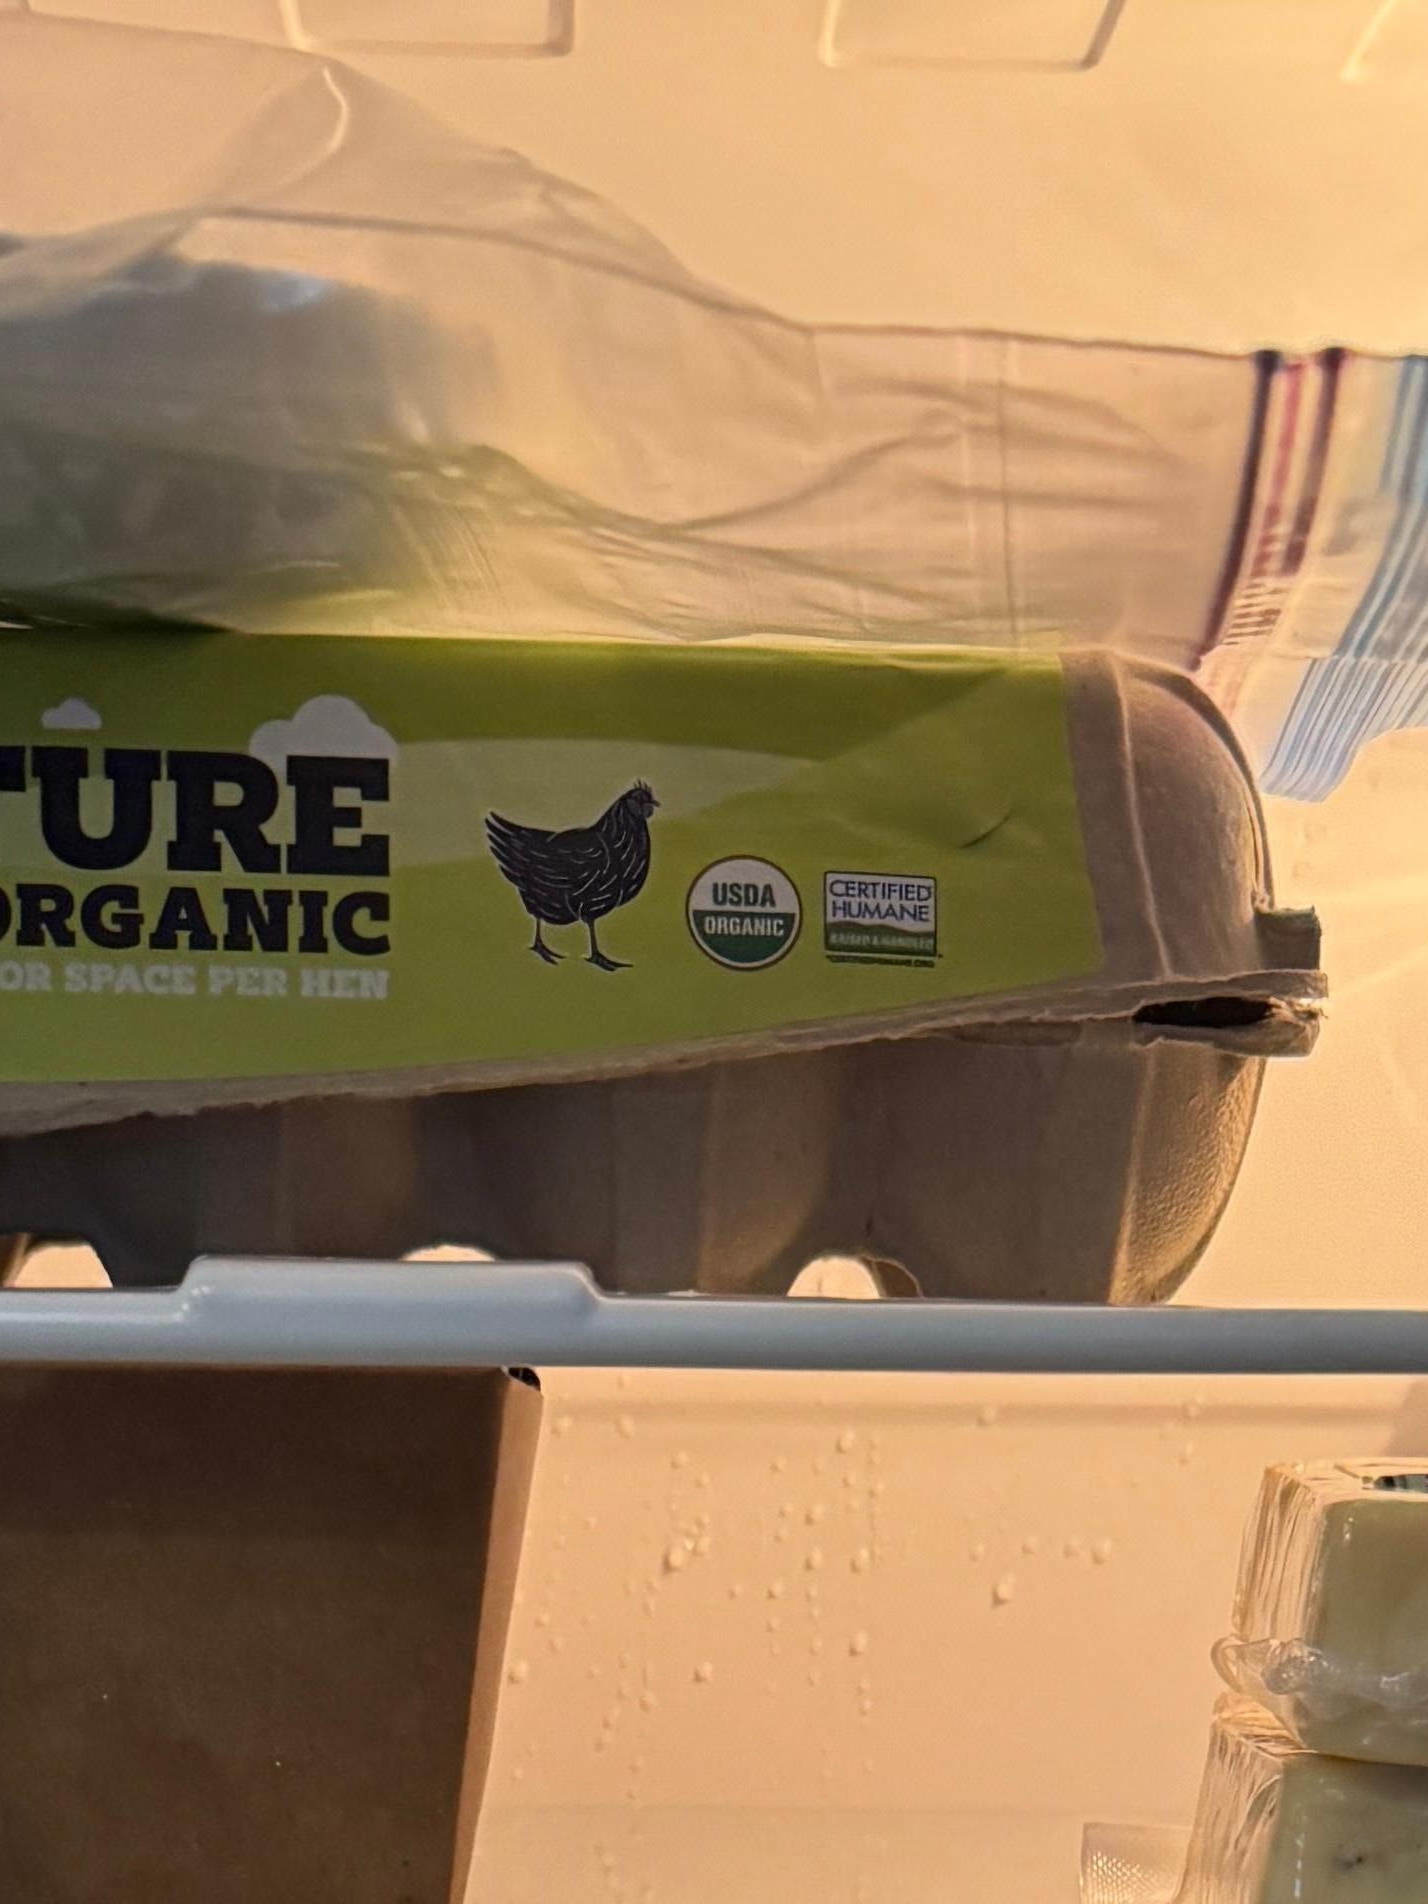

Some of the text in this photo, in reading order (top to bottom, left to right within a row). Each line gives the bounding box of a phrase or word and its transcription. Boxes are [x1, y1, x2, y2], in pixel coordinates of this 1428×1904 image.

[712, 881, 777, 909] USDA
[829, 880, 931, 901] CERTIFIED
[833, 900, 929, 922] HUMANE
[704, 916, 784, 938] ORGANIC
[65, 961, 196, 996] SPACE
[209, 965, 286, 997] PER
[300, 969, 389, 999] HEN
